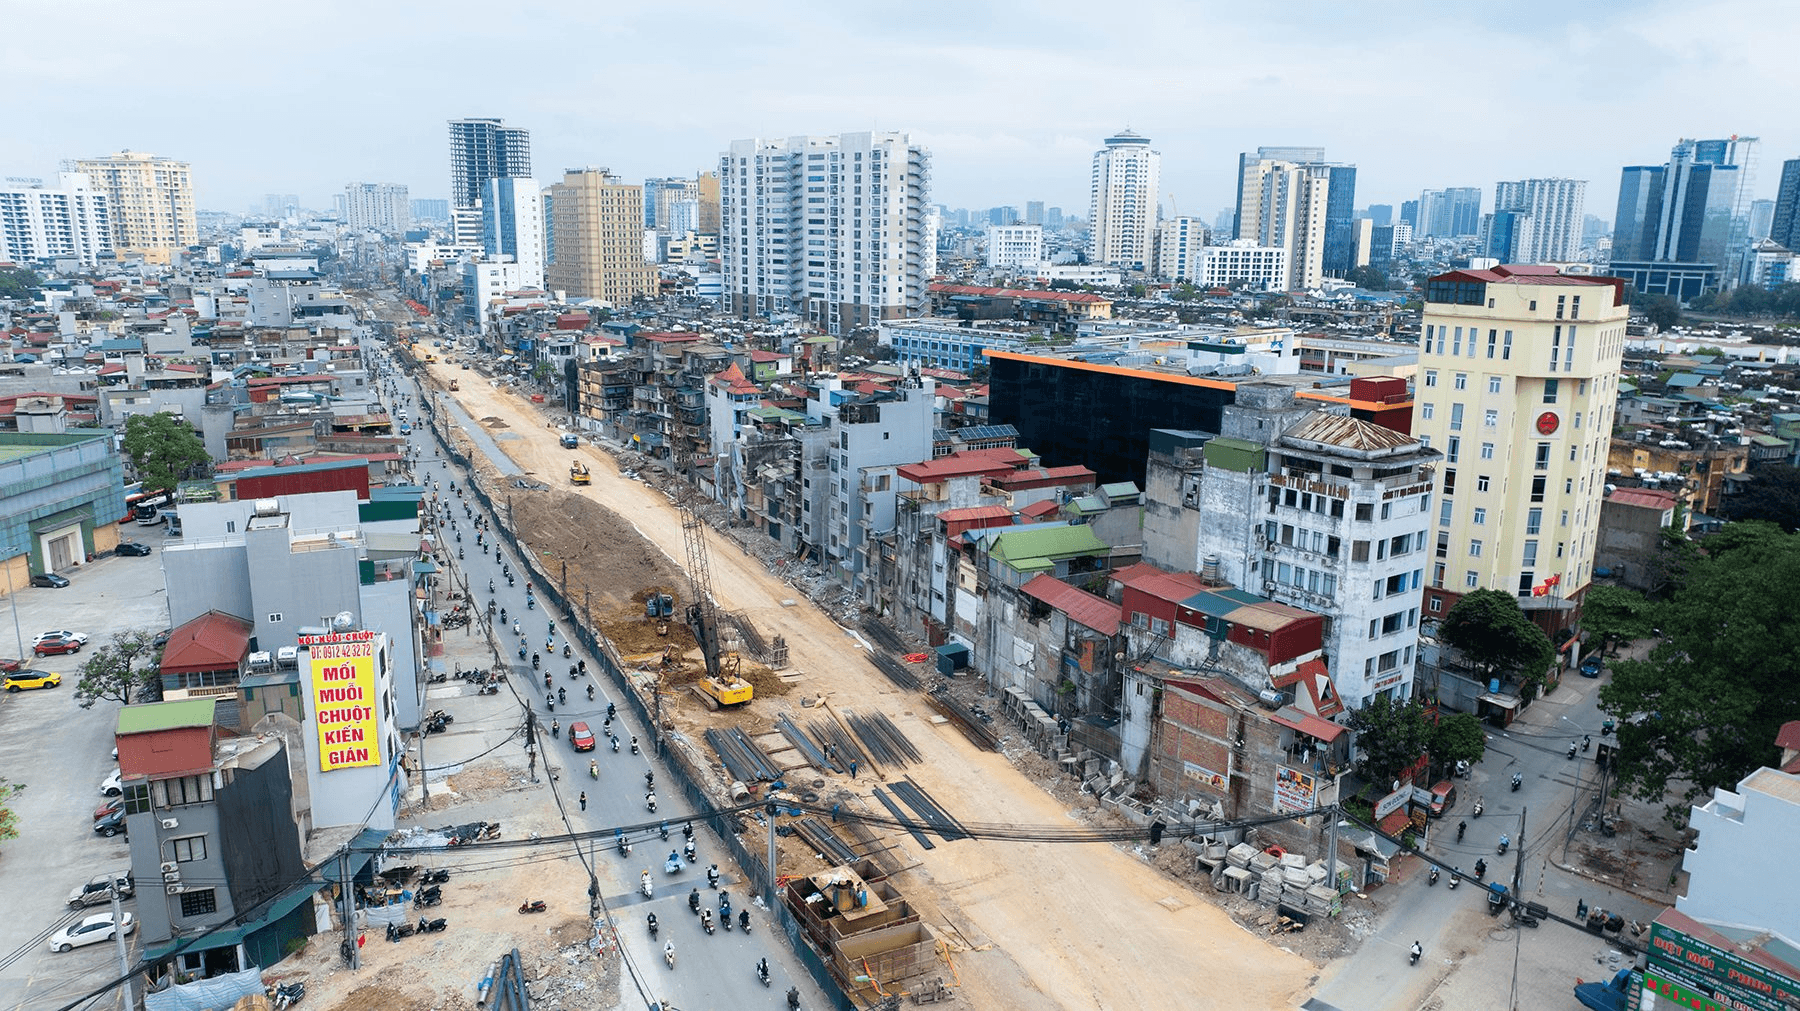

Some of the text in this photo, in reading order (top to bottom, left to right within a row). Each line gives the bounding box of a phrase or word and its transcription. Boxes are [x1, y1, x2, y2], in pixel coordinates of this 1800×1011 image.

[323, 646, 340, 658] 0912
[341, 645, 351, 657] 42
[351, 644, 361, 657] 32
[362, 643, 371, 656] 72
[323, 661, 356, 681] MỐI
[319, 683, 363, 703] MUỖI
[319, 705, 371, 724] CHUỘT
[325, 725, 364, 745] KIẾN
[329, 747, 369, 765] GIÁN
[1653, 936, 1684, 957] DIỆT
[1686, 950, 1715, 970] MỐI
[1728, 968, 1772, 992] PHUN
